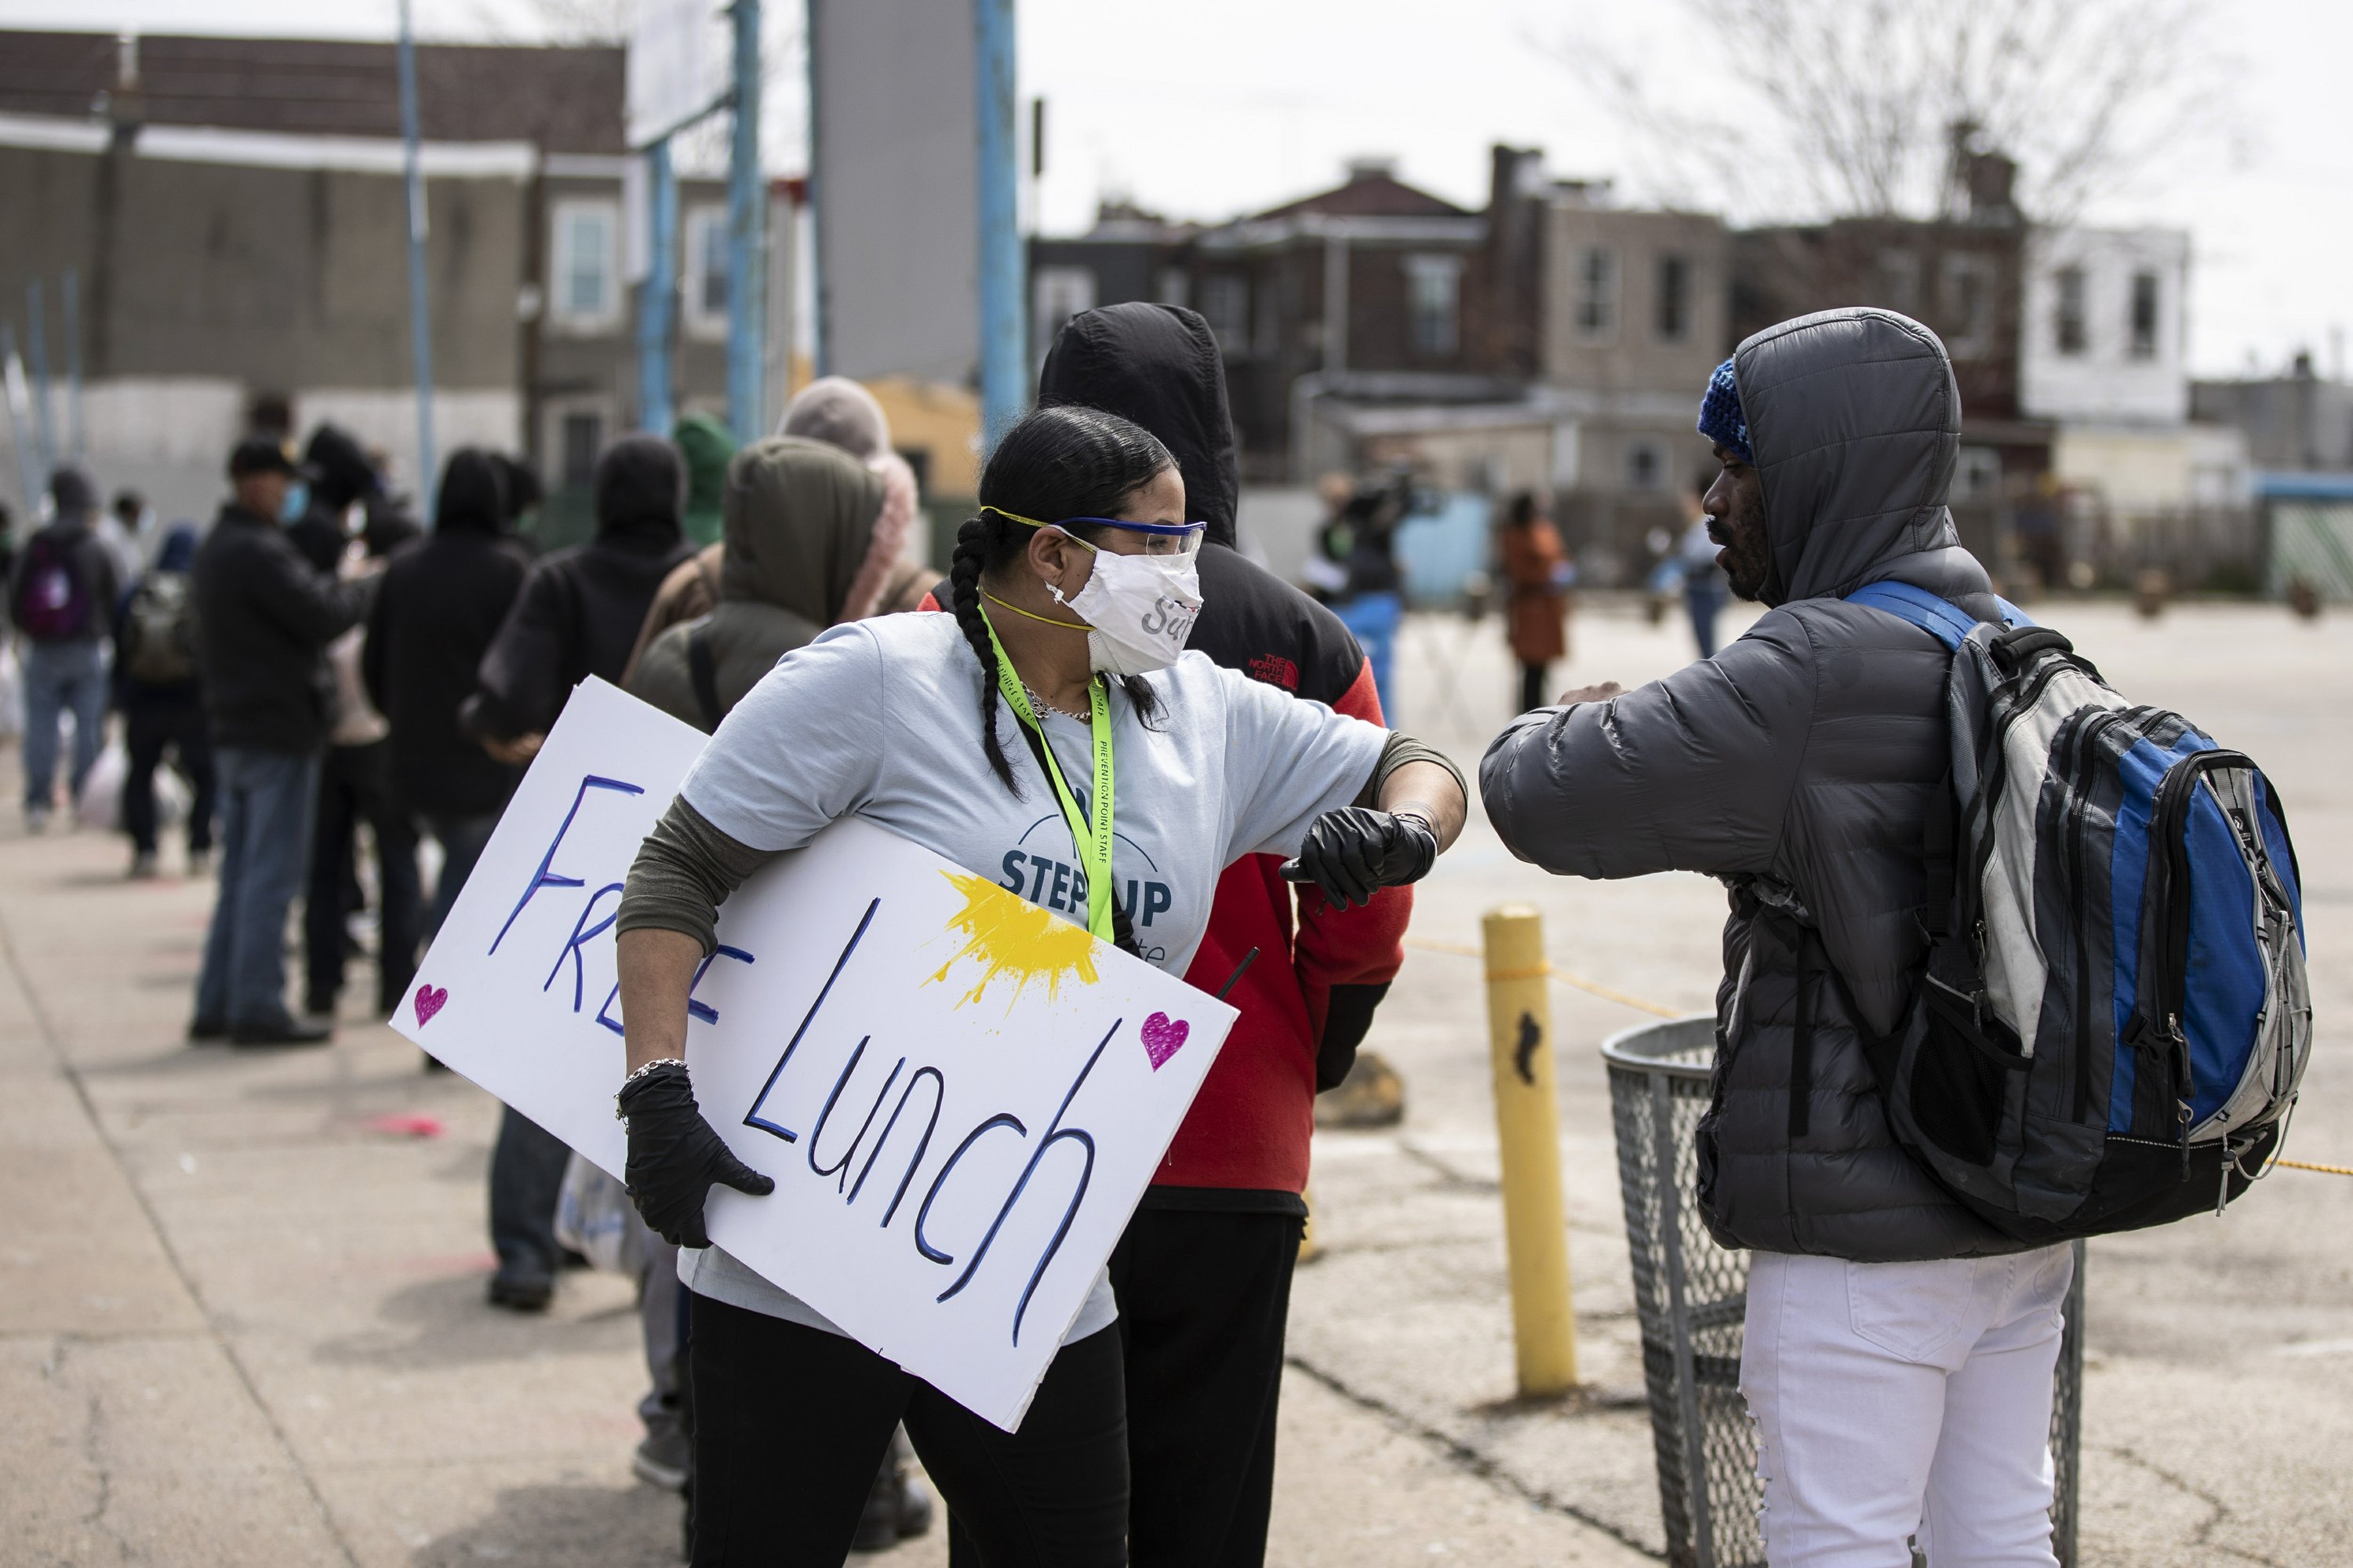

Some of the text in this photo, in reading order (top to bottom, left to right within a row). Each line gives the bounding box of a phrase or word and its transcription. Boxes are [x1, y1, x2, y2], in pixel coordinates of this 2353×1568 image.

[1249, 659, 1283, 675] NORTH
[1255, 670, 1282, 684] FACE
[1264, 653, 1286, 666] THE
[1099, 740, 1109, 864] PREVENTION POINT STAFF
[998, 849, 1088, 915] STEP
[743, 897, 1122, 1348] Lunch
